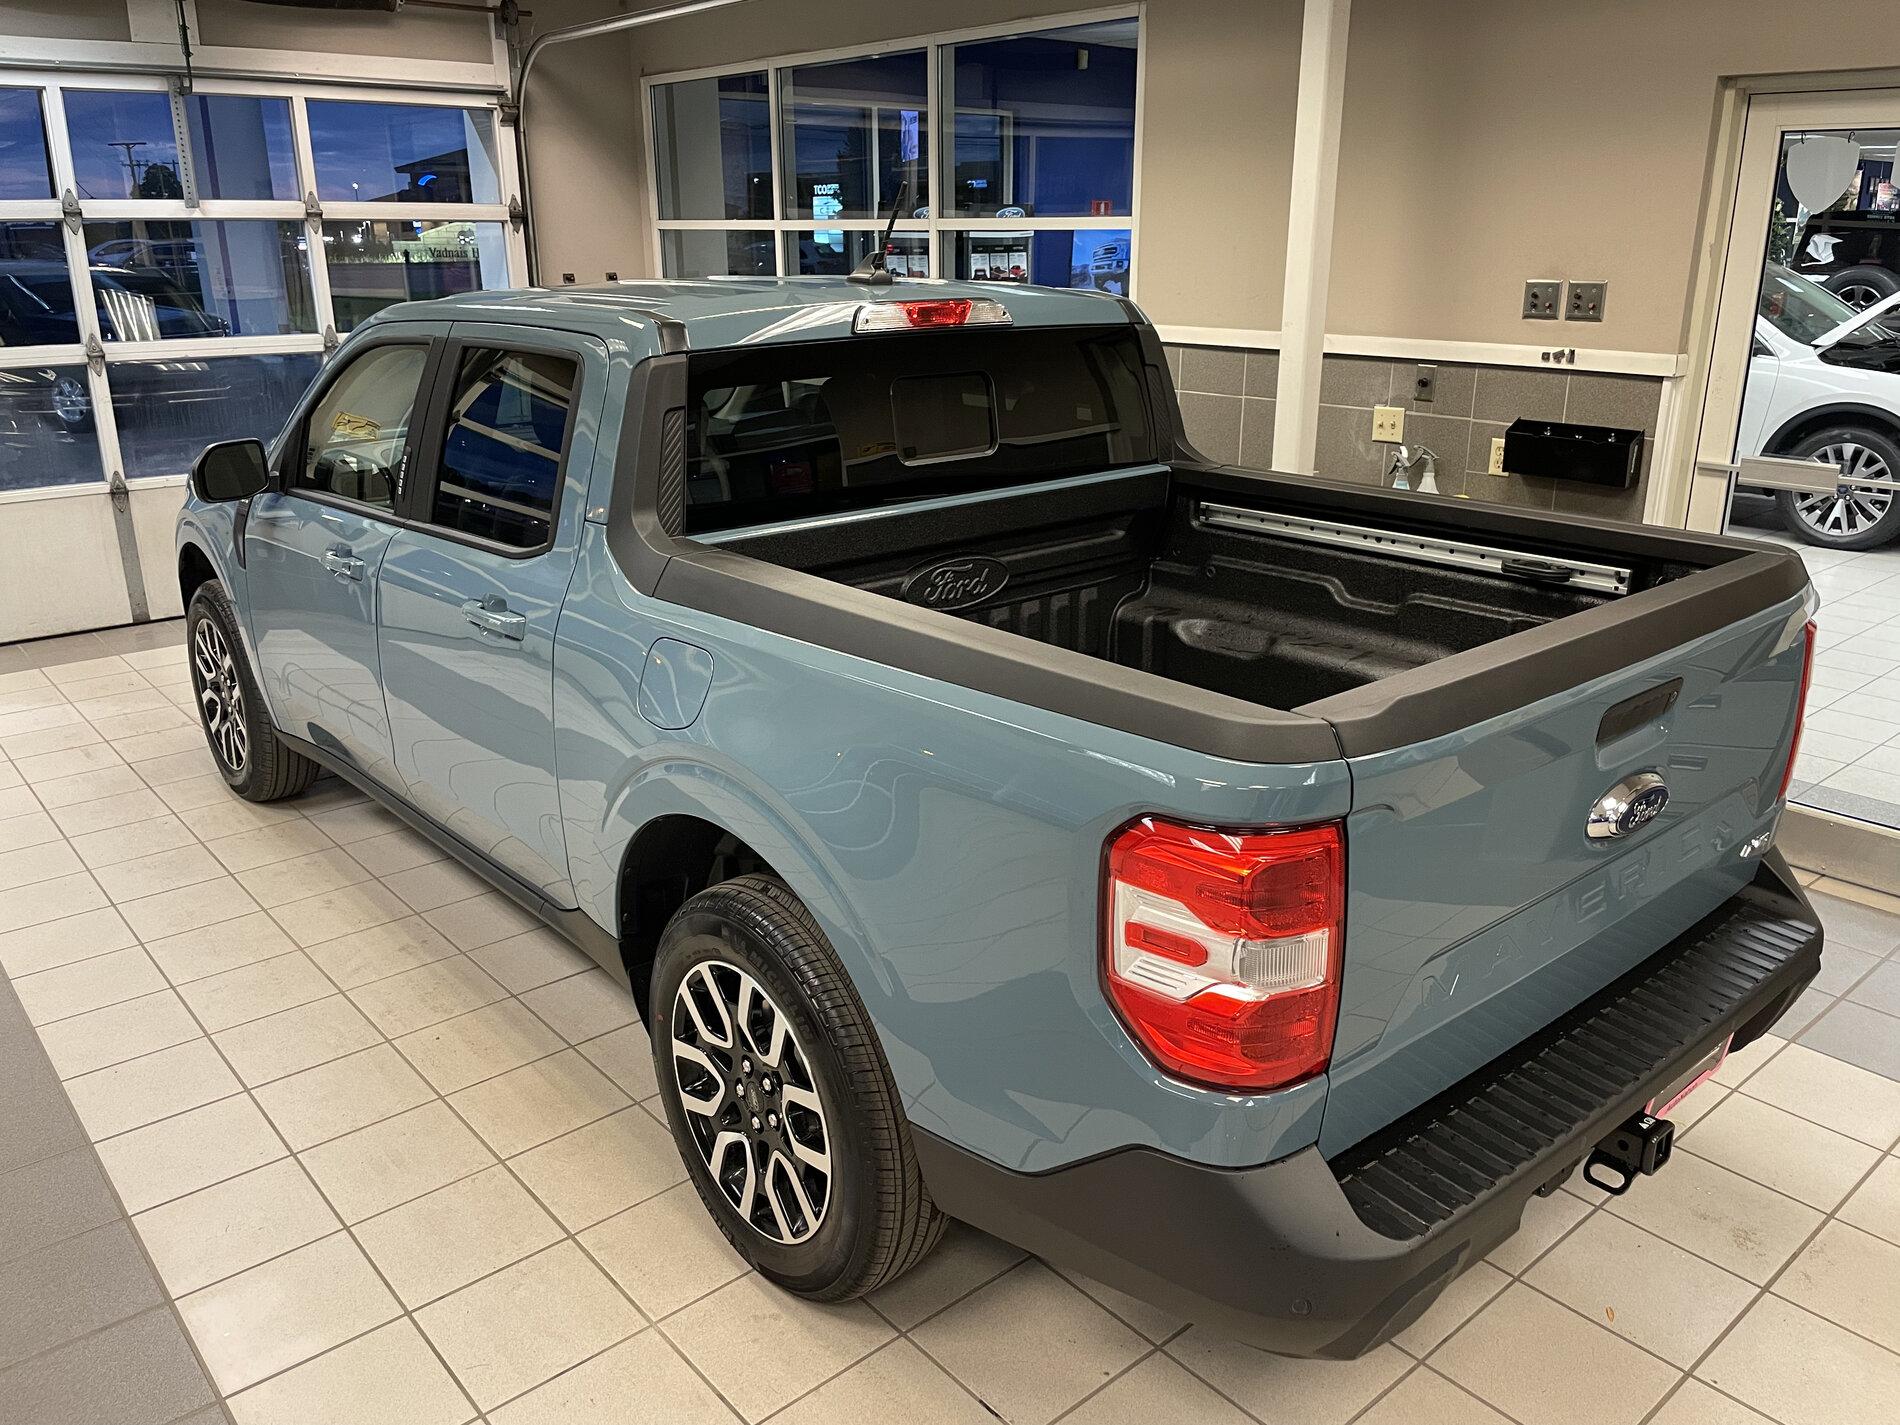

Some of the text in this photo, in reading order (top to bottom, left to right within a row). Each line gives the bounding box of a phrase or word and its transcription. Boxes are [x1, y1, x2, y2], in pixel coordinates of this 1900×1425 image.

[428, 247, 469, 259] Vadnais
[923, 563, 989, 602] Ford
[1628, 795, 1662, 829] Ford
